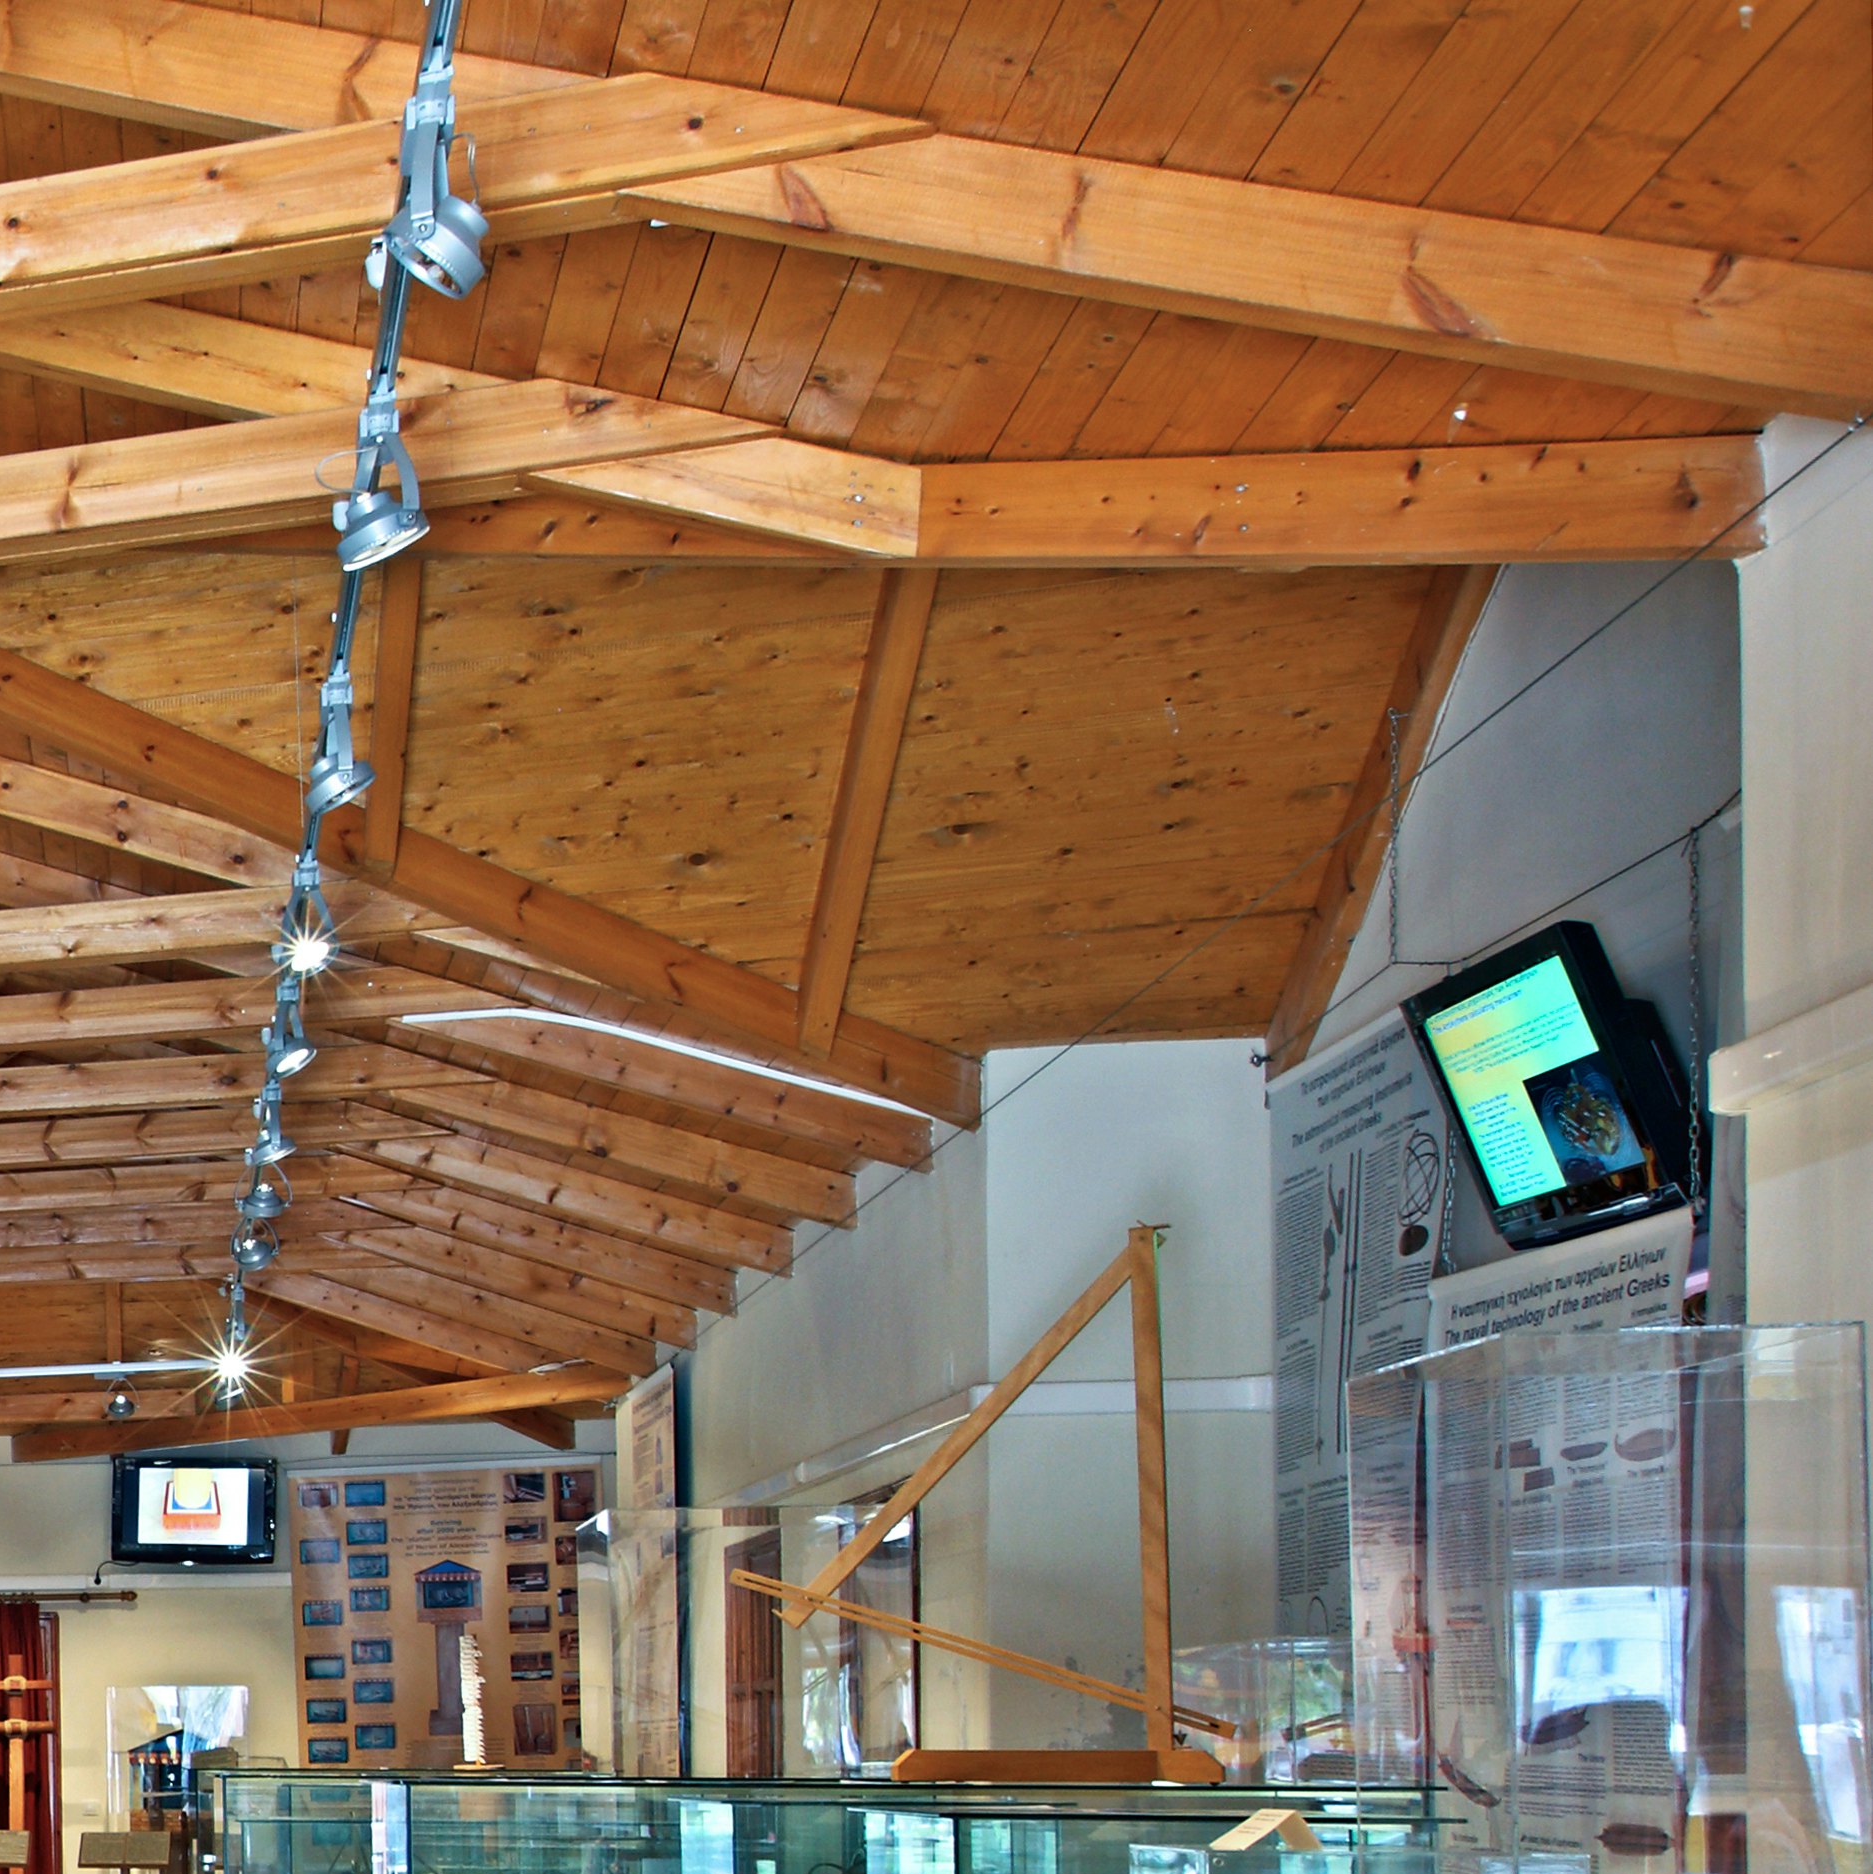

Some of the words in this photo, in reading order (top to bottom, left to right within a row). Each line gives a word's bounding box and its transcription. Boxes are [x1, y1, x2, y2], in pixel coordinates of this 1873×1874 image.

[1445, 1329, 1460, 1346] The
[1462, 1321, 1489, 1341] naval
[1491, 1307, 1545, 1333] technology
[1548, 1301, 1561, 1319] of
[1562, 1298, 1579, 1314] the
[1581, 1285, 1624, 1309] ancient
[1627, 1272, 1670, 1297] Greeks
